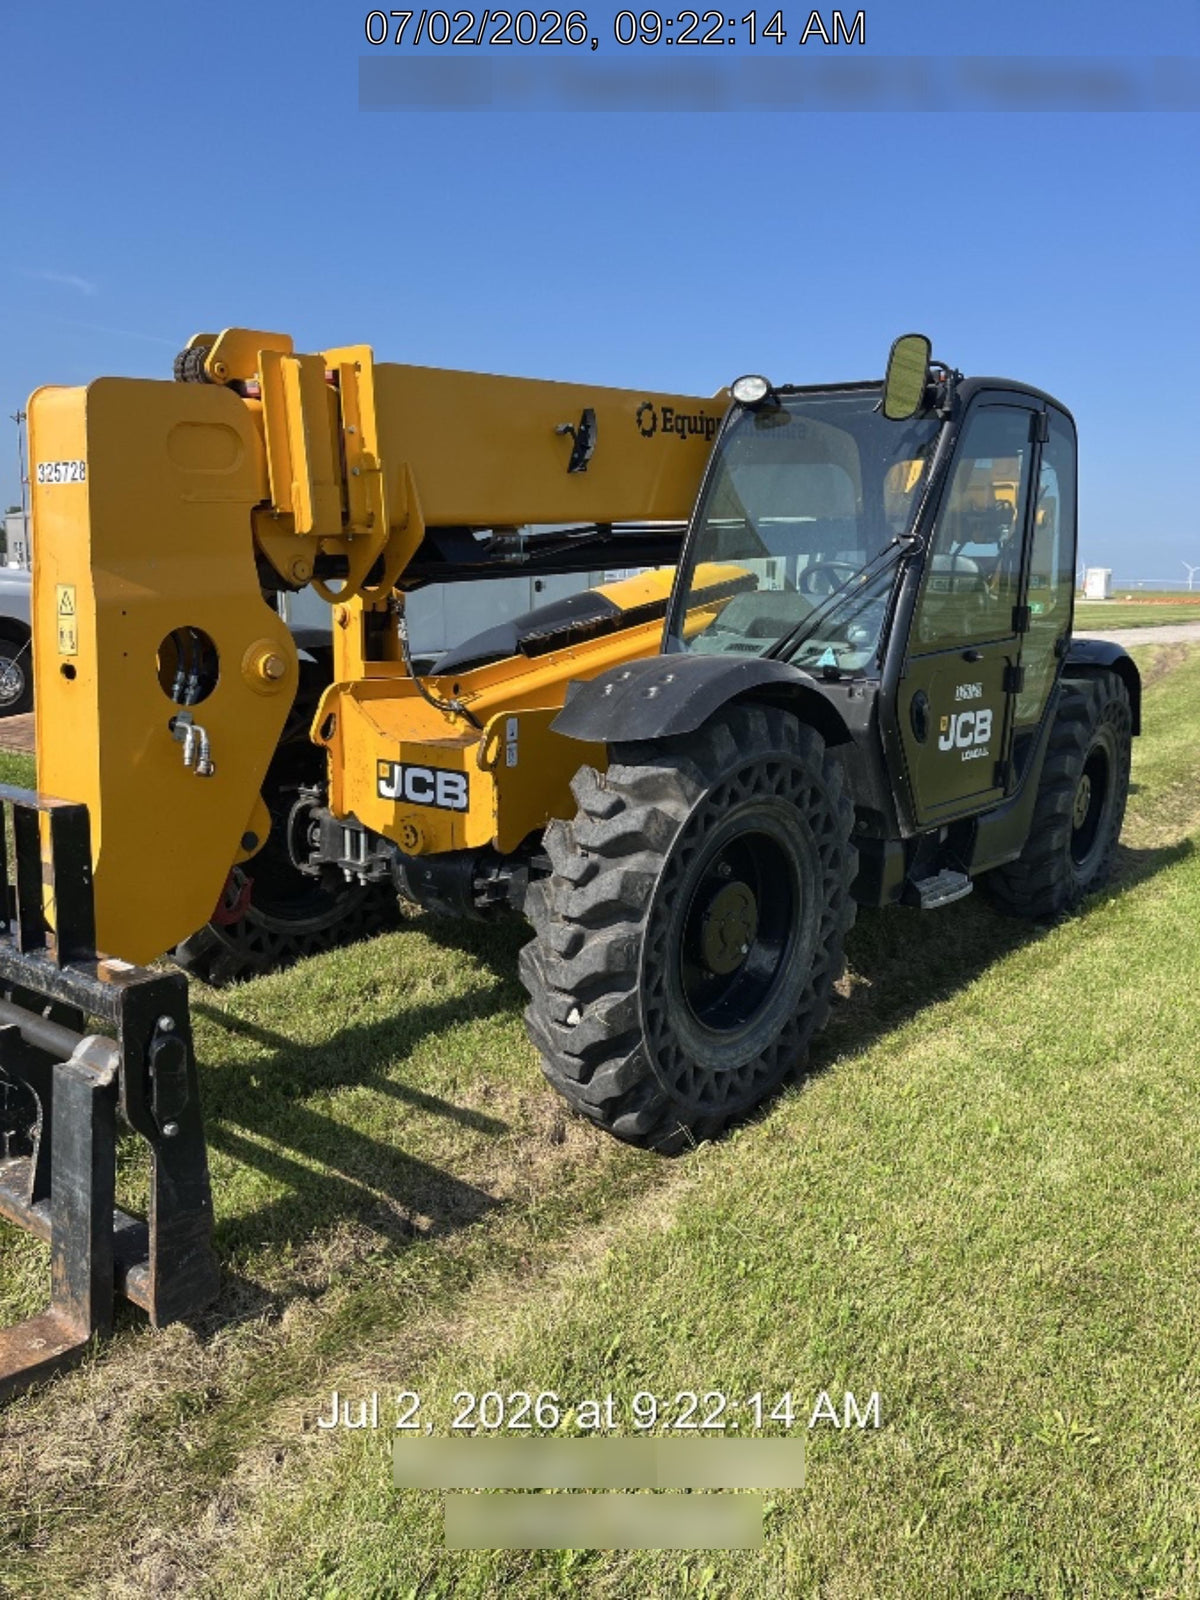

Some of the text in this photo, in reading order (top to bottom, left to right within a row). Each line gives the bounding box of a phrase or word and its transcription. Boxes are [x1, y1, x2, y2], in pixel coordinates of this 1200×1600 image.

[38, 461, 86, 482] 325728
[938, 708, 993, 751] JCB
[378, 762, 469, 809] JCB
